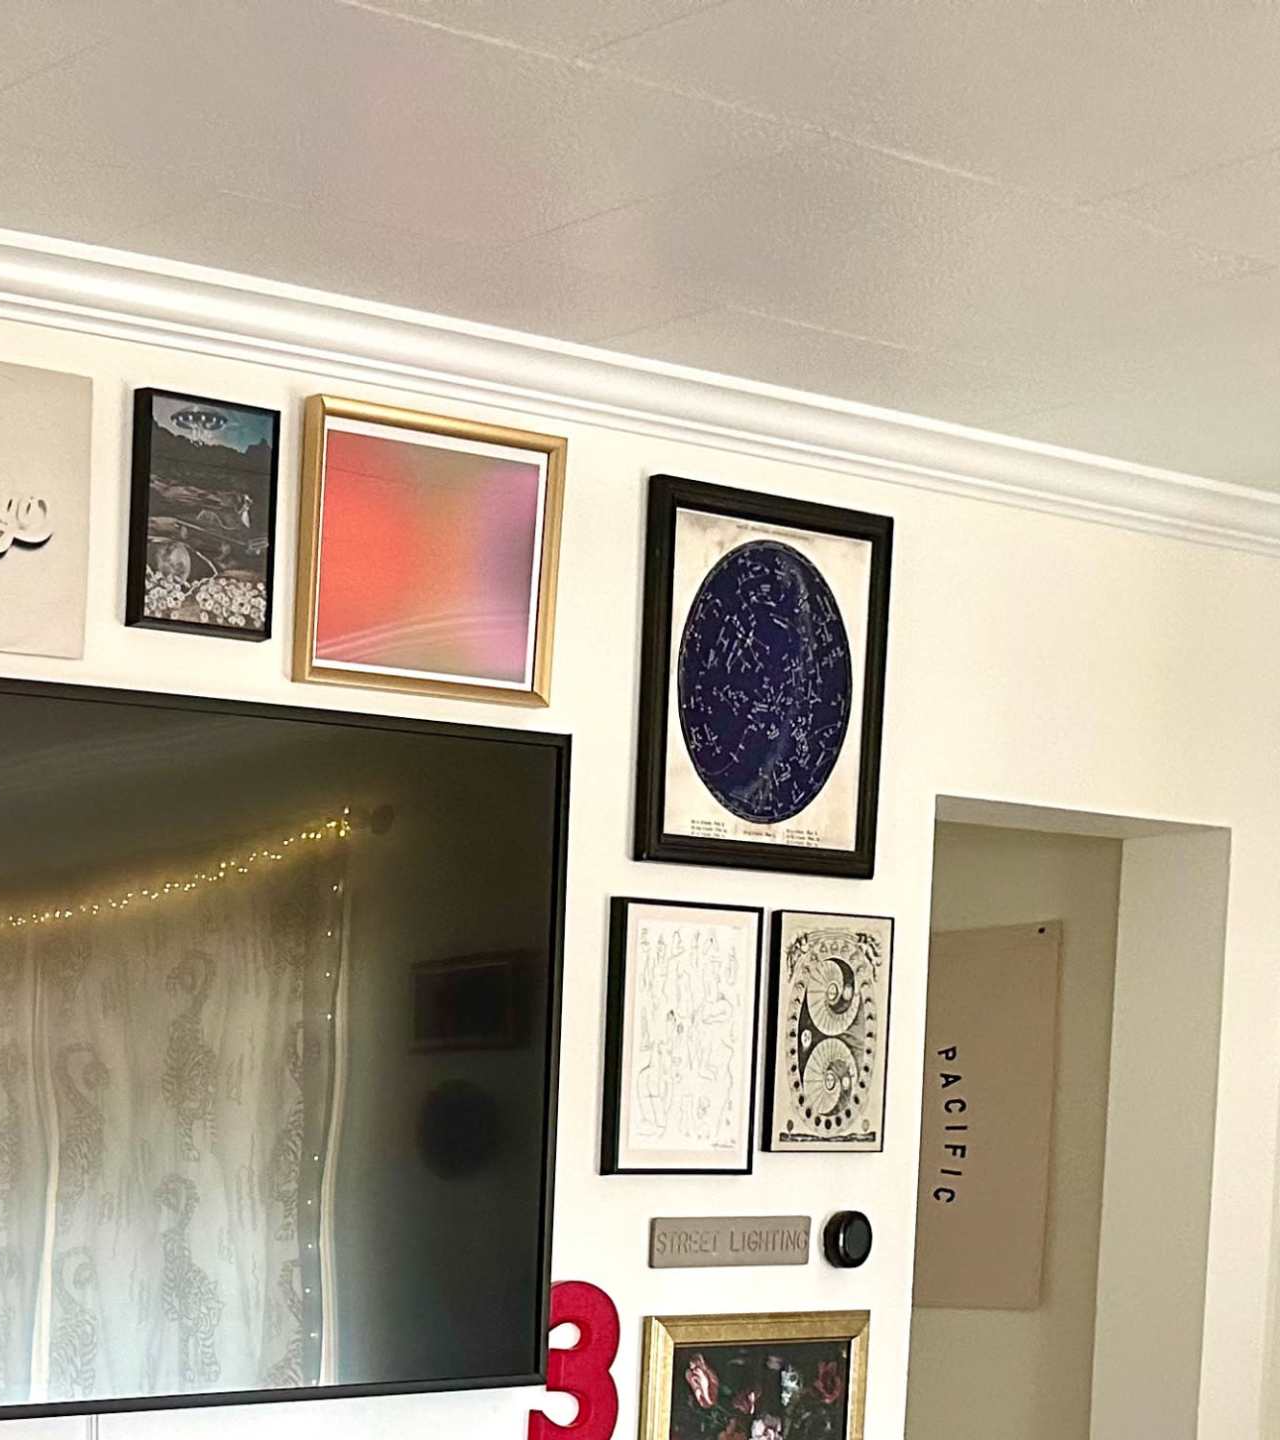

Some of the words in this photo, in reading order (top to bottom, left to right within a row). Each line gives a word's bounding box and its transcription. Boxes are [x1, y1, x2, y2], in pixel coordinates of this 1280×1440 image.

[933, 1046, 968, 1203] PACIFIC
[656, 1231, 720, 1255] STREET
[729, 1229, 809, 1253] LIGHTING
